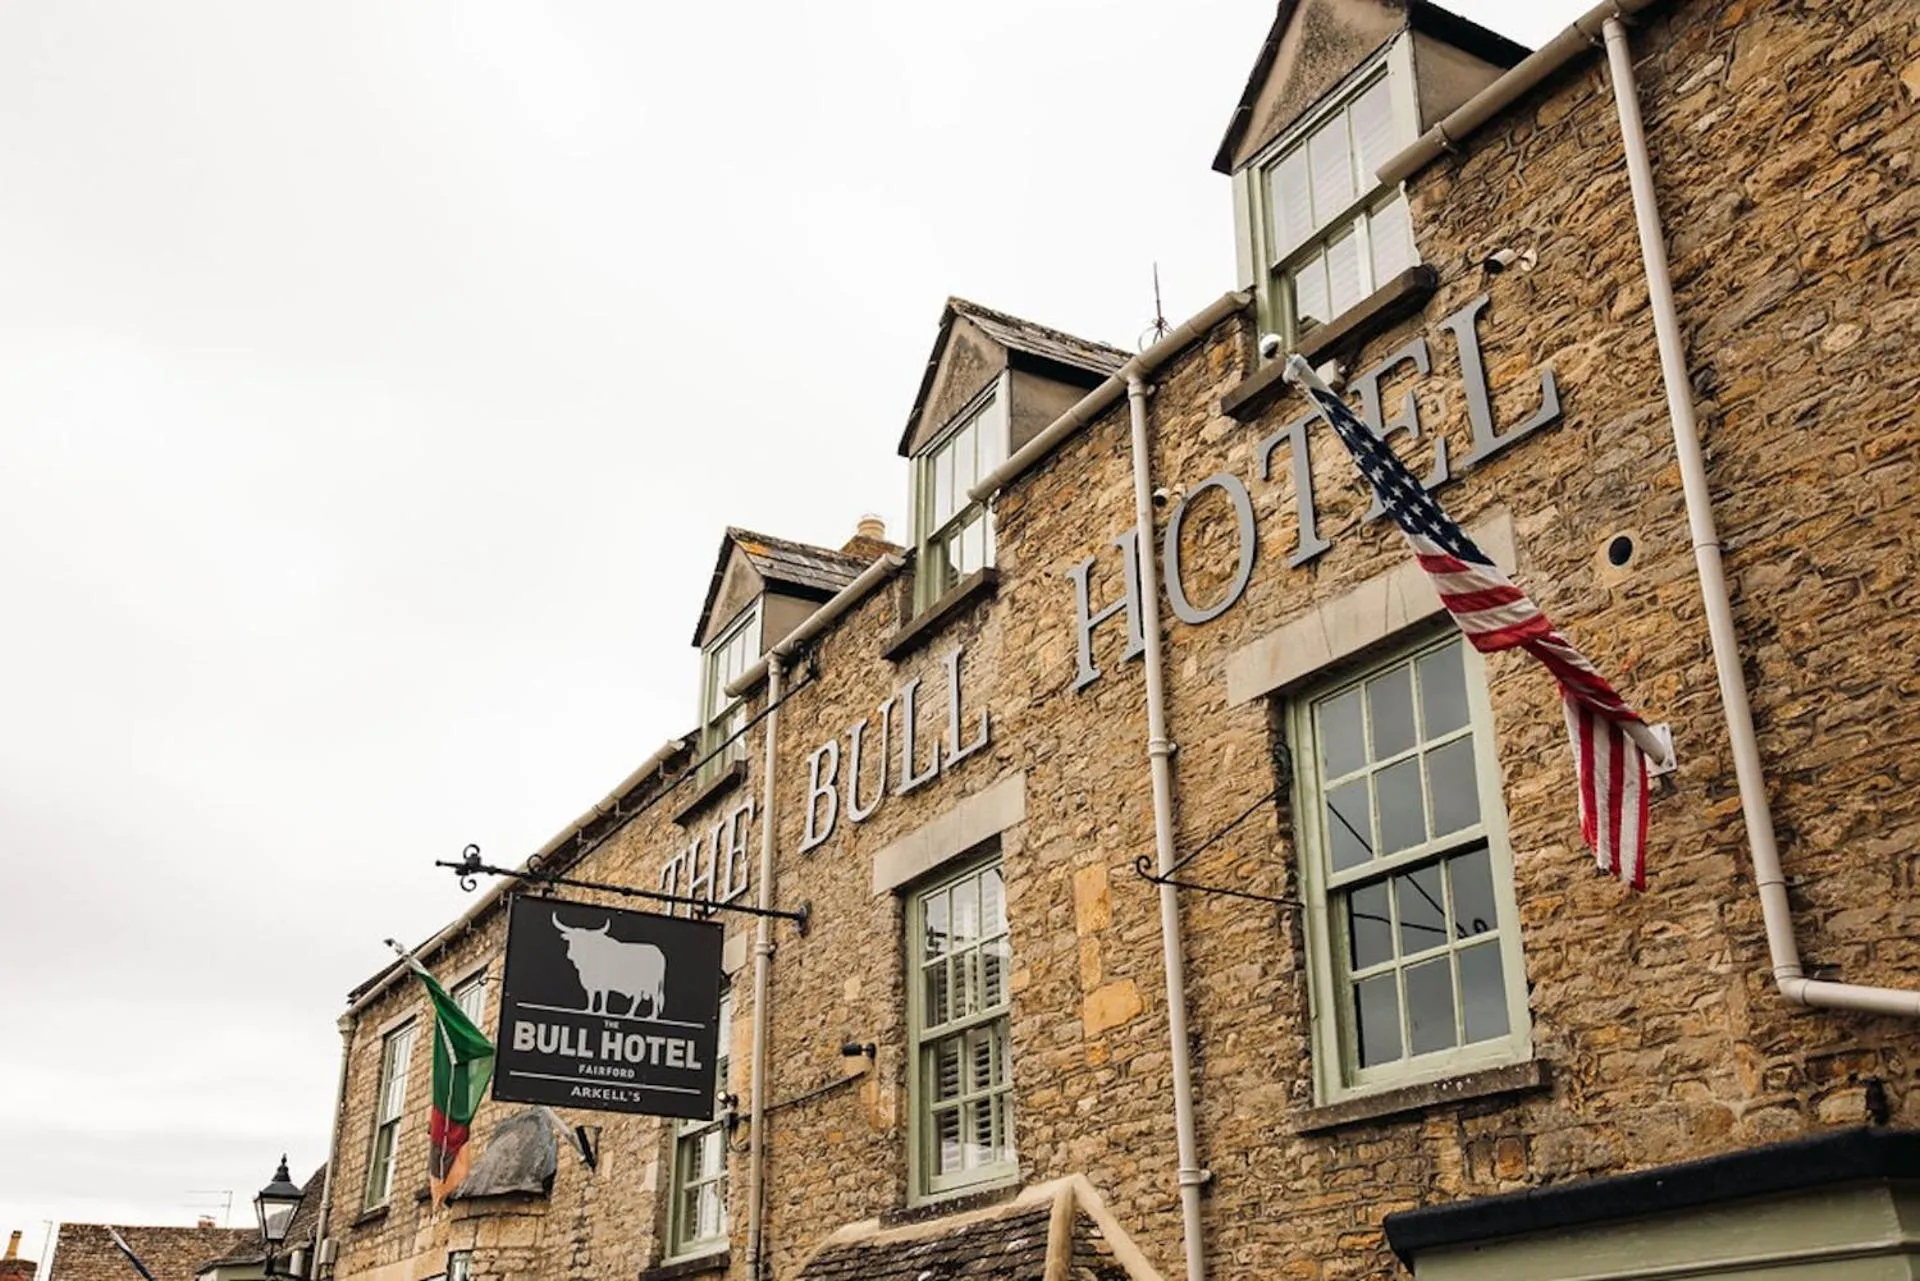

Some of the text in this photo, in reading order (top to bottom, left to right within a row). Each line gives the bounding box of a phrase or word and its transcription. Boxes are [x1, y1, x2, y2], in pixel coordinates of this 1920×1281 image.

[660, 293, 1562, 918] THE BULL HOTEL
[604, 1020, 620, 1030] THE
[513, 1020, 703, 1070] BULL HOTEL
[578, 1064, 636, 1079] FAIRFORD
[571, 1085, 642, 1103] ARKELL'S
